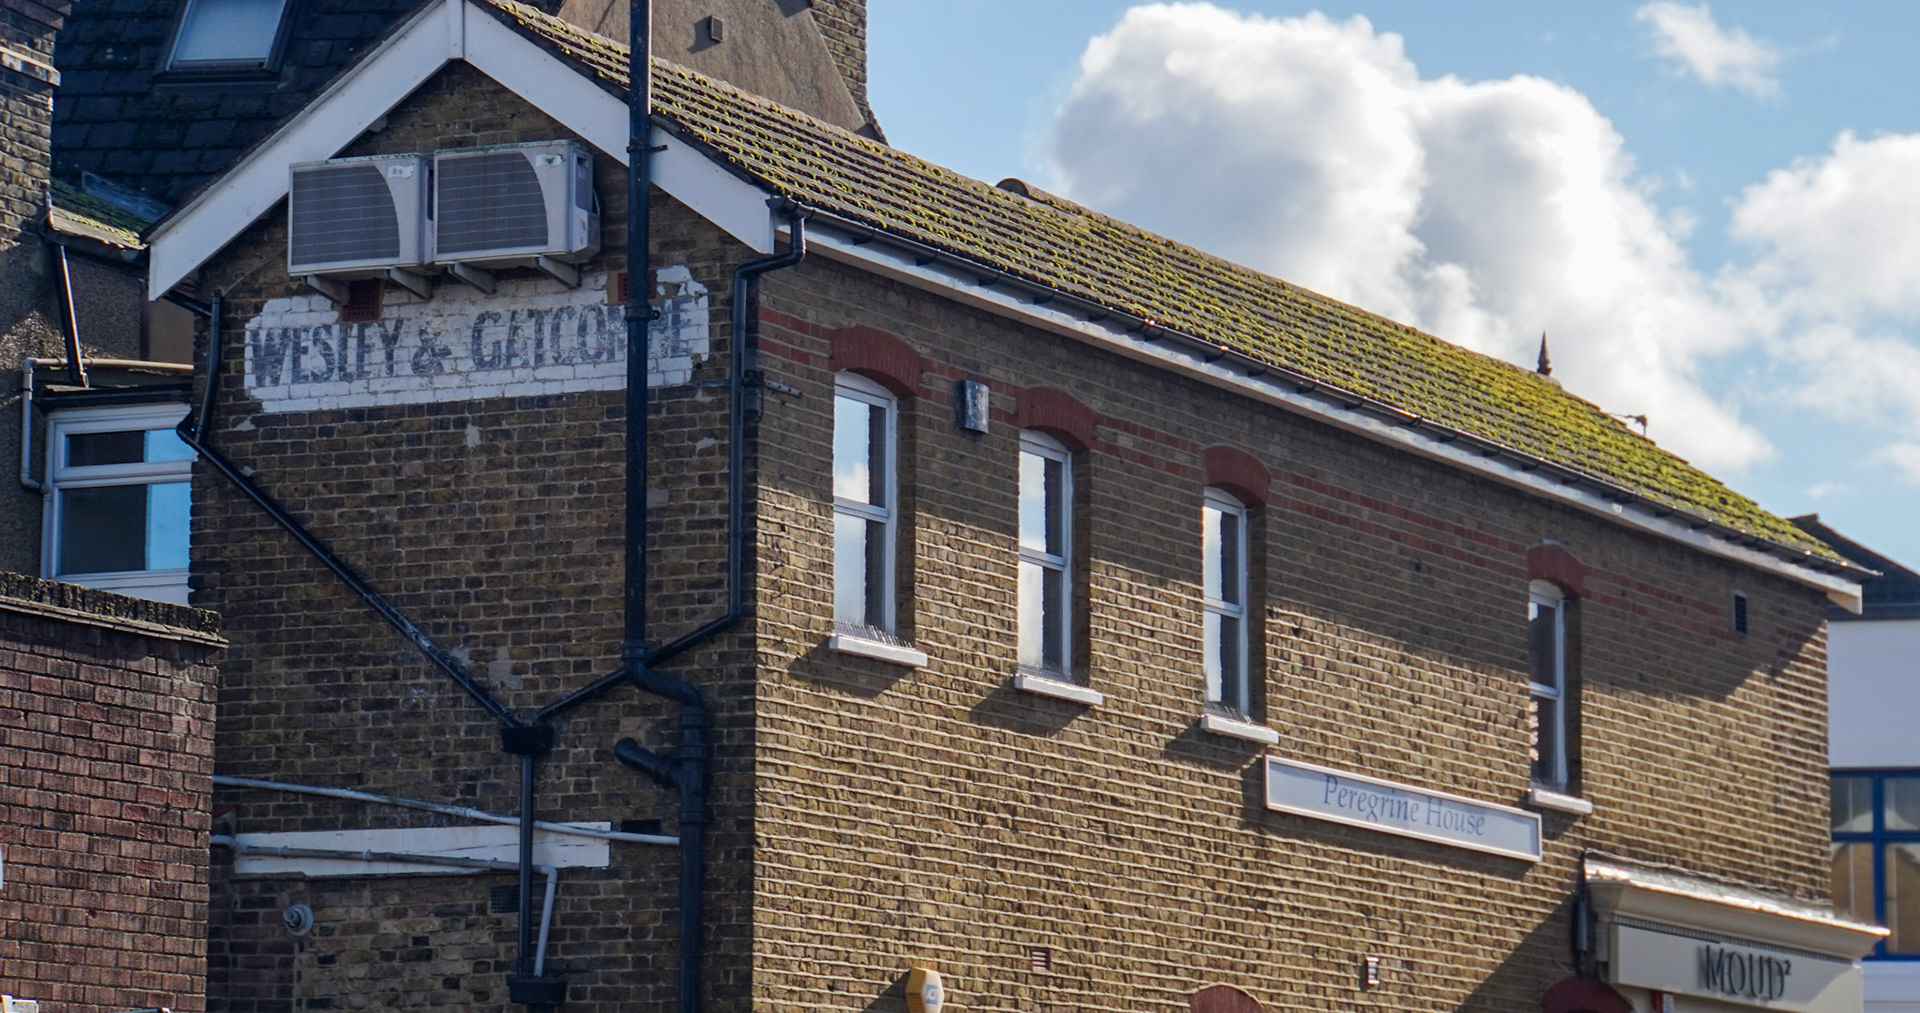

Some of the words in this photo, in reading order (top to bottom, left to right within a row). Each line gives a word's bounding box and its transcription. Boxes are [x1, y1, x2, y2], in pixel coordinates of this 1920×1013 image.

[250, 318, 405, 388] WESLEY
[410, 320, 453, 375] &
[1322, 774, 1419, 824] Peregrine
[1425, 795, 1486, 837] House
